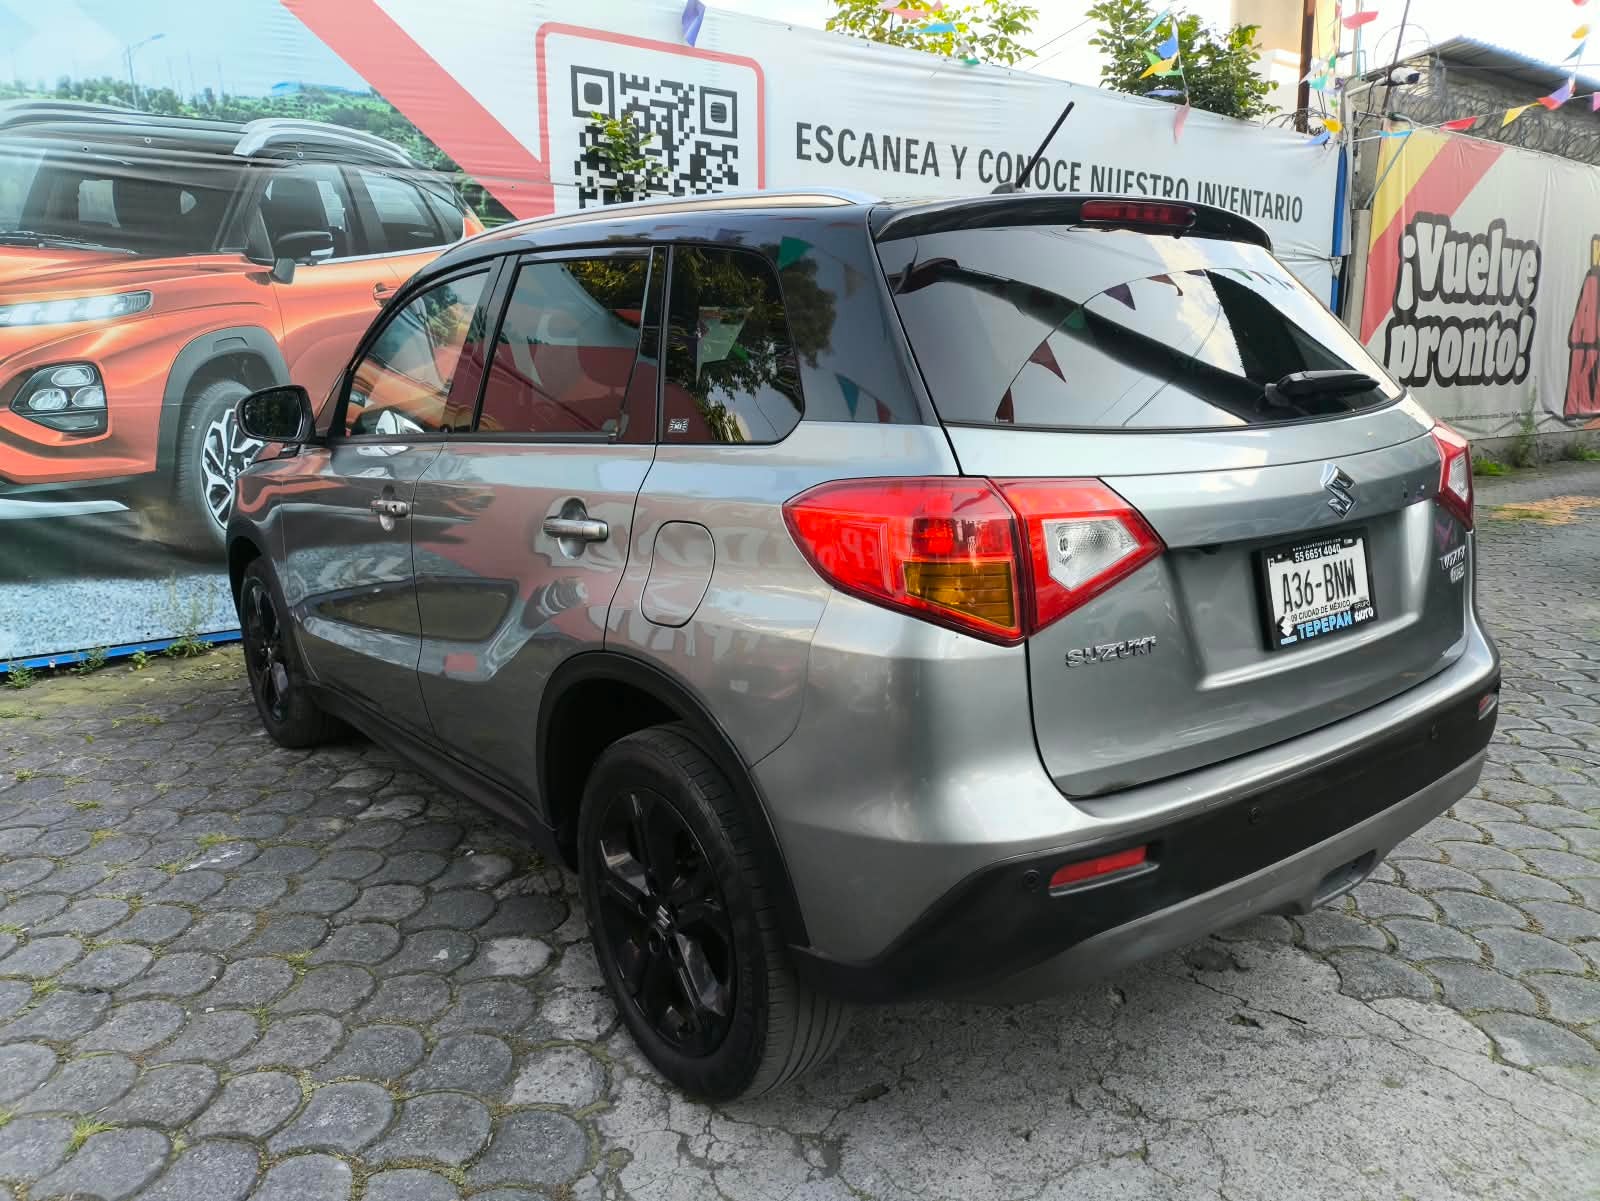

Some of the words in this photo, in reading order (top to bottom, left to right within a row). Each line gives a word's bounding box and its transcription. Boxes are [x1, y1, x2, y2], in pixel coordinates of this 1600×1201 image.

[796, 121, 940, 177] ESCANEA
[951, 144, 968, 180] Y
[978, 148, 1082, 193] CONOCE
[1197, 180, 1303, 223] INVENTARIO
[1396, 216, 1540, 312] ¡Vuelve
[1387, 311, 1535, 385] pronto!
[1282, 558, 1356, 614] A36-BNW
[1298, 608, 1320, 620] CIUDAD
[1320, 605, 1329, 614] DE
[1065, 636, 1156, 668] SUZUKI
[1297, 611, 1353, 639] TEPEPAN
